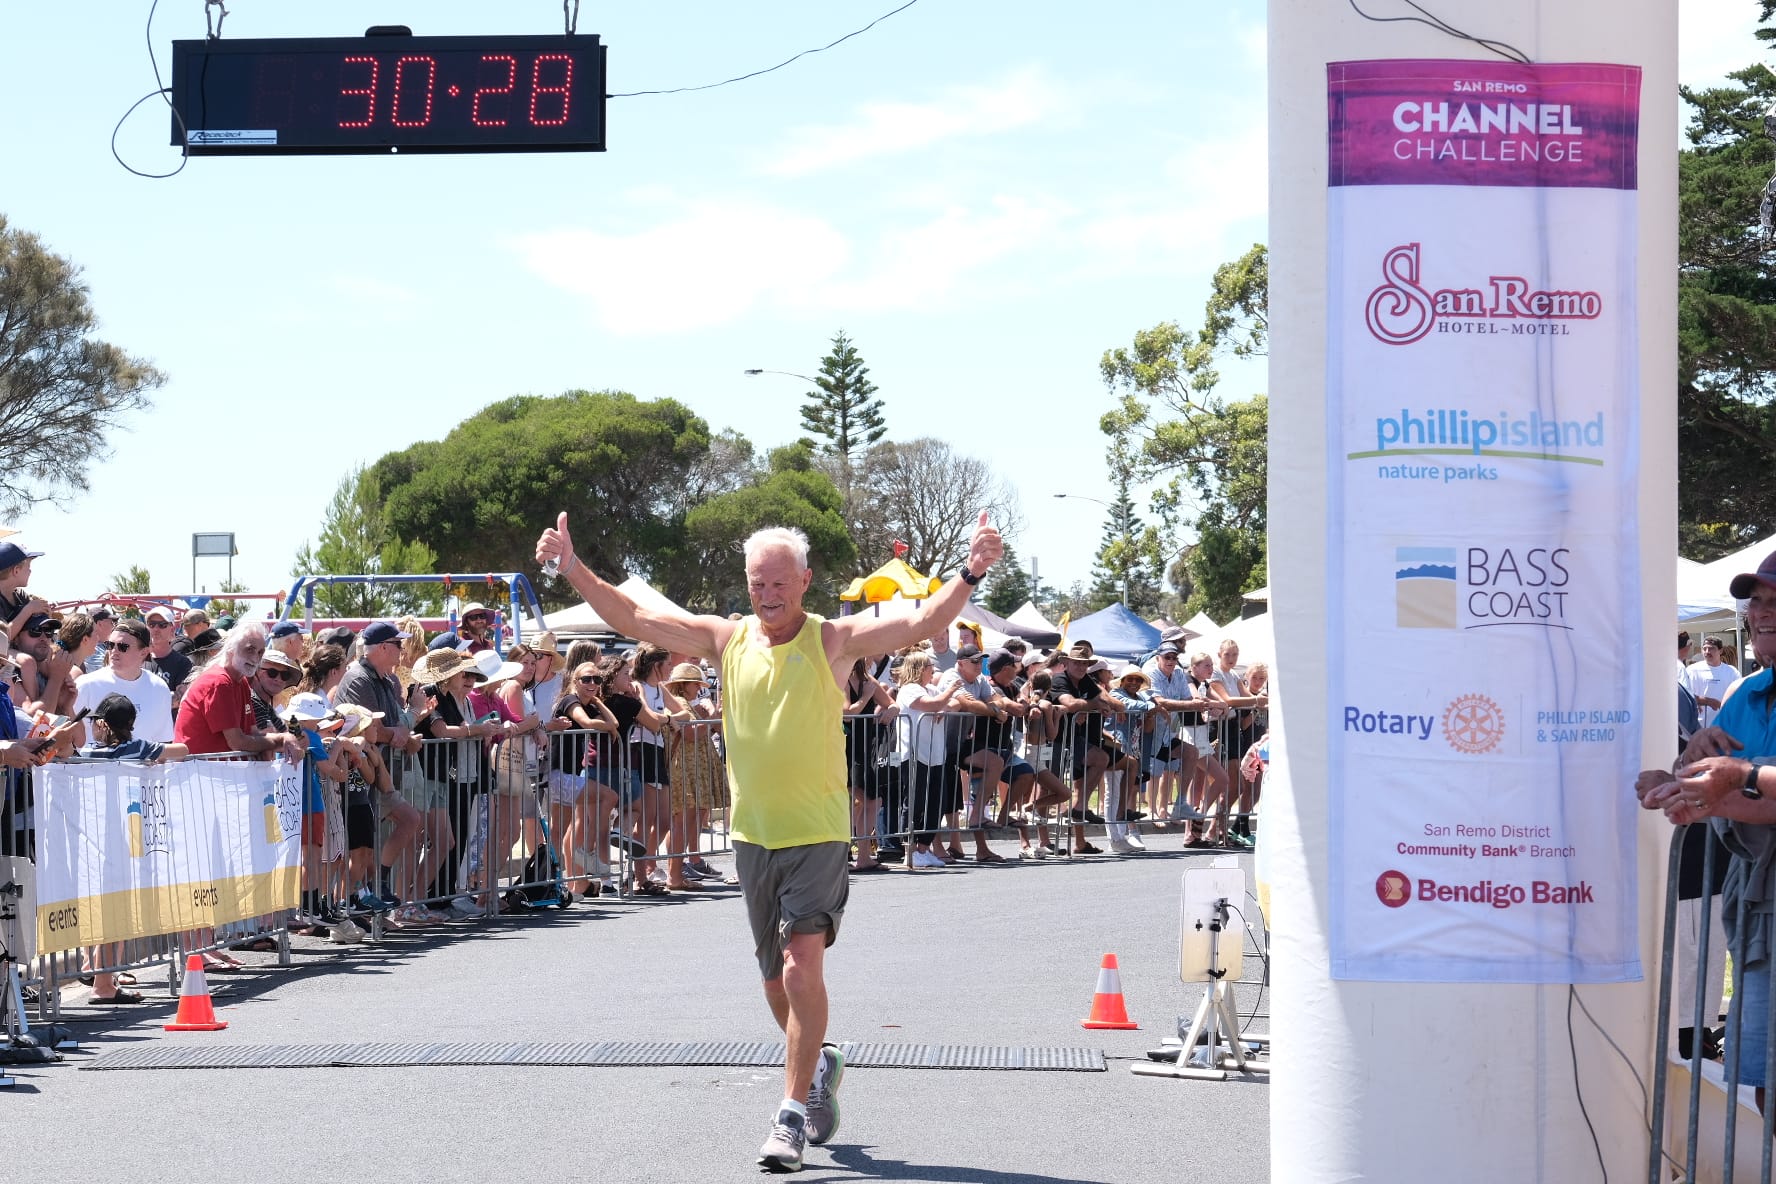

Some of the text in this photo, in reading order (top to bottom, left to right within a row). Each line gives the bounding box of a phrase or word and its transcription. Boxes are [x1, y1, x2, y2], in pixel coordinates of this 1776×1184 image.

[1453, 80, 1527, 94] SAN REMO
[1393, 101, 1583, 135] CHANNEL
[1393, 139, 1583, 162] CHALLENGE
[1366, 243, 1602, 345] San Remo
[1378, 463, 1498, 483] nature parks
[1468, 547, 1570, 587] BASS
[1468, 591, 1569, 618] COAST
[1344, 706, 1434, 740] Rotary
[1537, 710, 1631, 724] PHILLIP ISLAND
[1537, 728, 1615, 742] & SAN REMO
[142, 785, 166, 819] BASS
[1424, 823, 1551, 838] San Remo District
[1397, 842, 1476, 859] Community
[1530, 845, 1576, 858] Branch
[193, 885, 219, 908] events
[1418, 879, 1594, 909] Bendigo Bank
[48, 904, 78, 931] events
